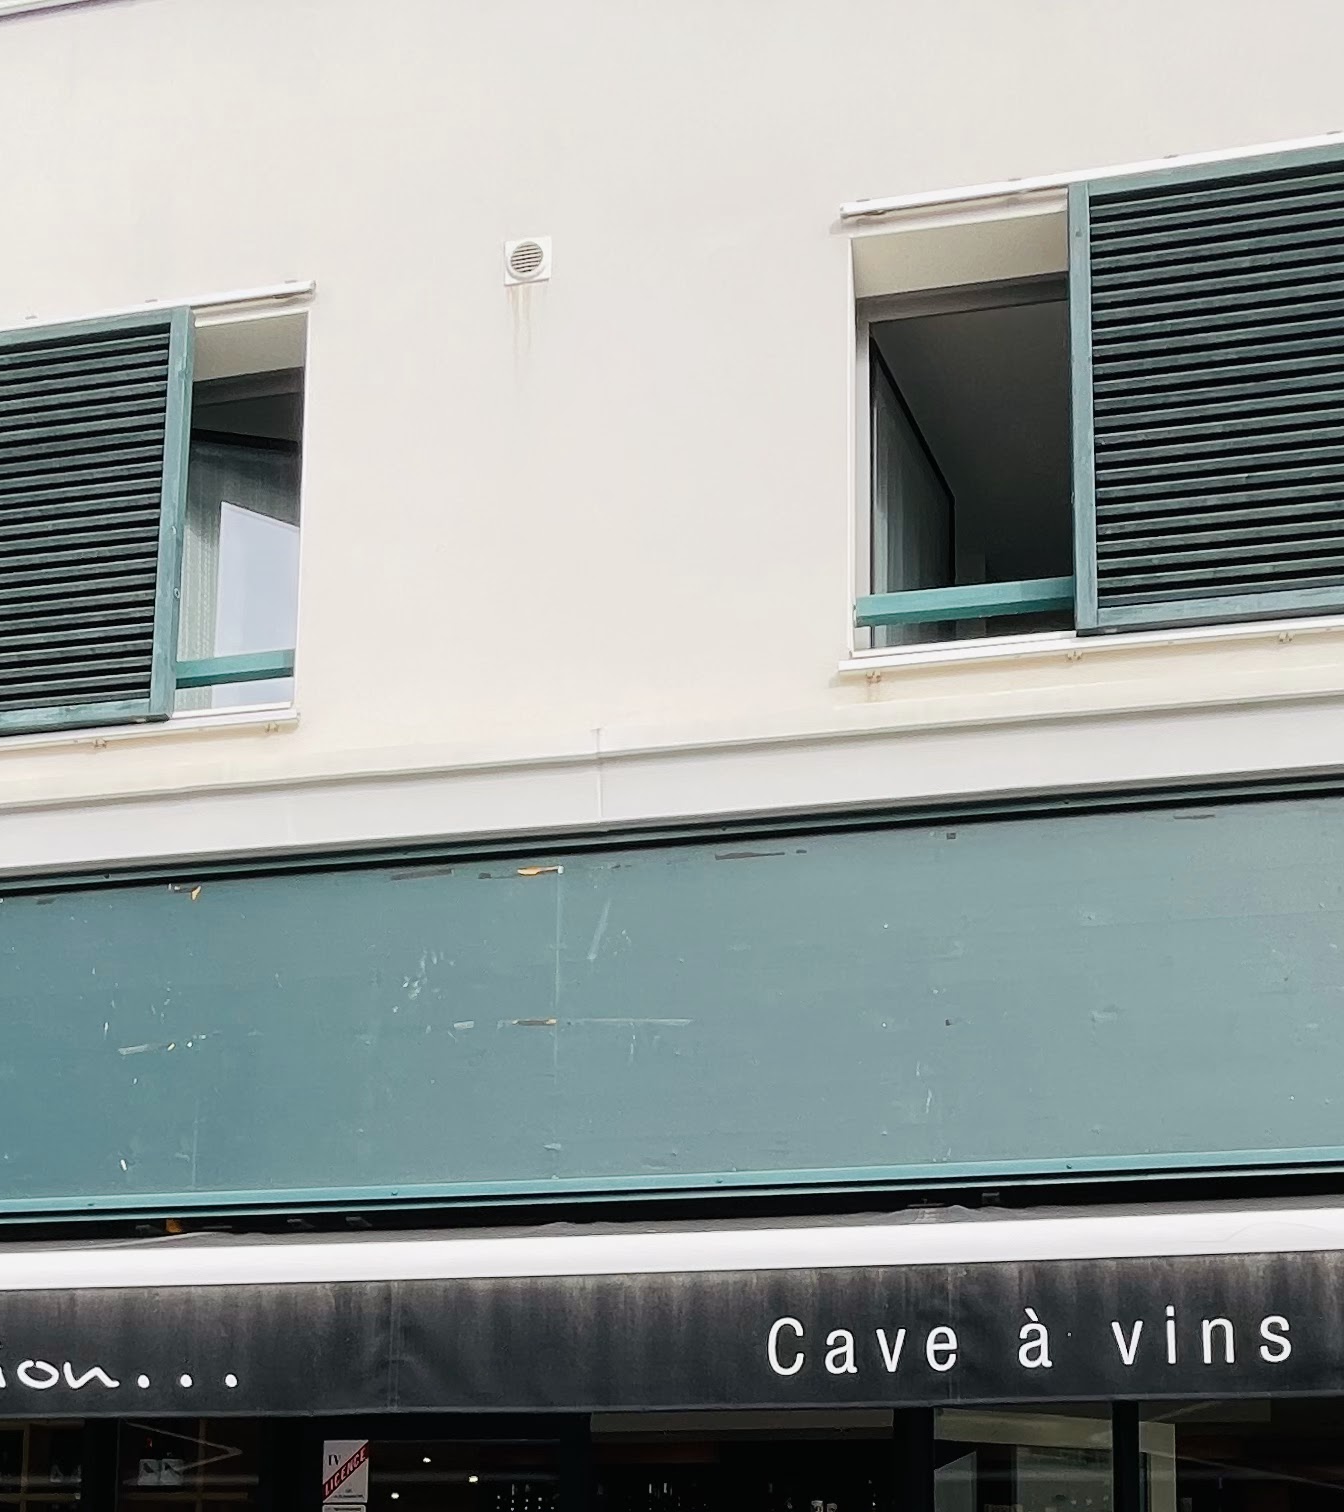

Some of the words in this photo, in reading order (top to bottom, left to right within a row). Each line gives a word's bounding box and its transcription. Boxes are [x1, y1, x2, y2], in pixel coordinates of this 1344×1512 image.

[766, 1316, 959, 1377] Cave
[1017, 1306, 1053, 1370] à
[1110, 1304, 1294, 1366] vins
[324, 1446, 367, 1497] LICENCE
